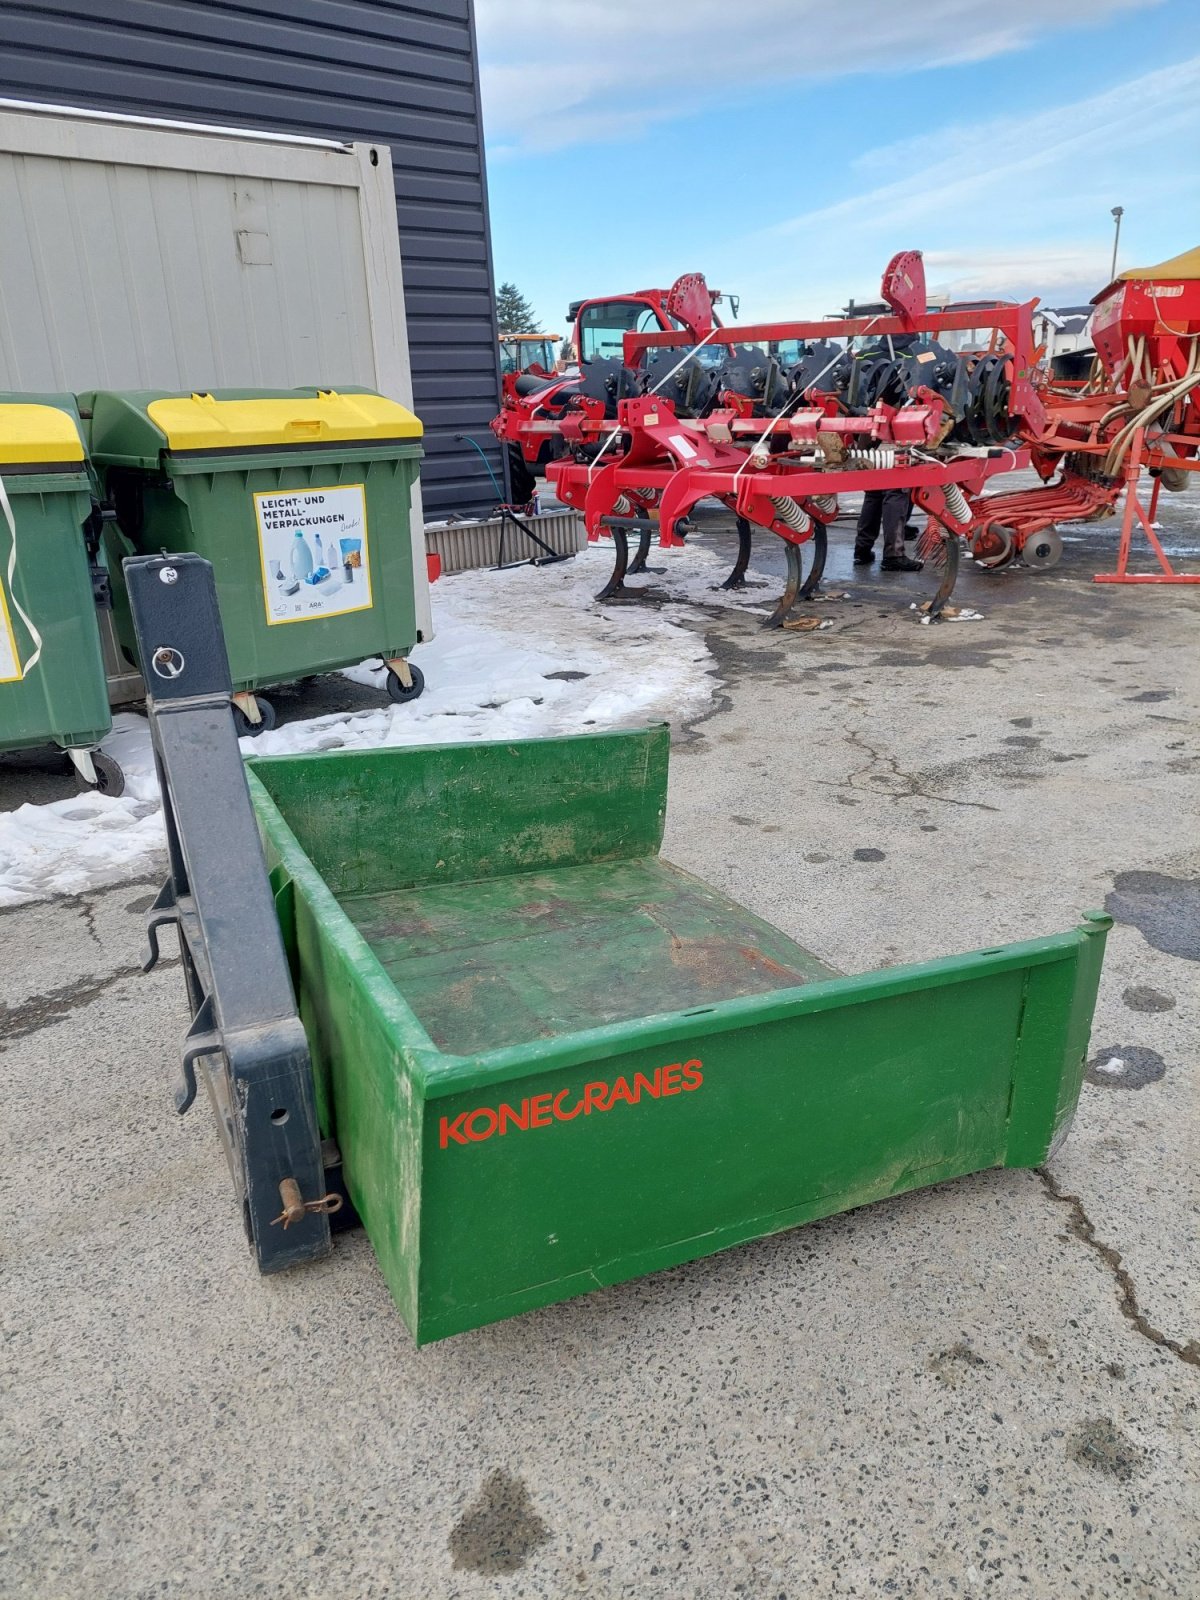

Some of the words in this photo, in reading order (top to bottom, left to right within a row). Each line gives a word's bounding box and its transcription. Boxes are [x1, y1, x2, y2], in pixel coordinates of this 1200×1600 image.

[262, 498, 301, 509] LEICHT-
[304, 496, 325, 505] UND
[263, 508, 306, 519] METALL-
[265, 514, 345, 530] VERPACKUNGEN
[439, 1059, 704, 1149] KONECRANES
